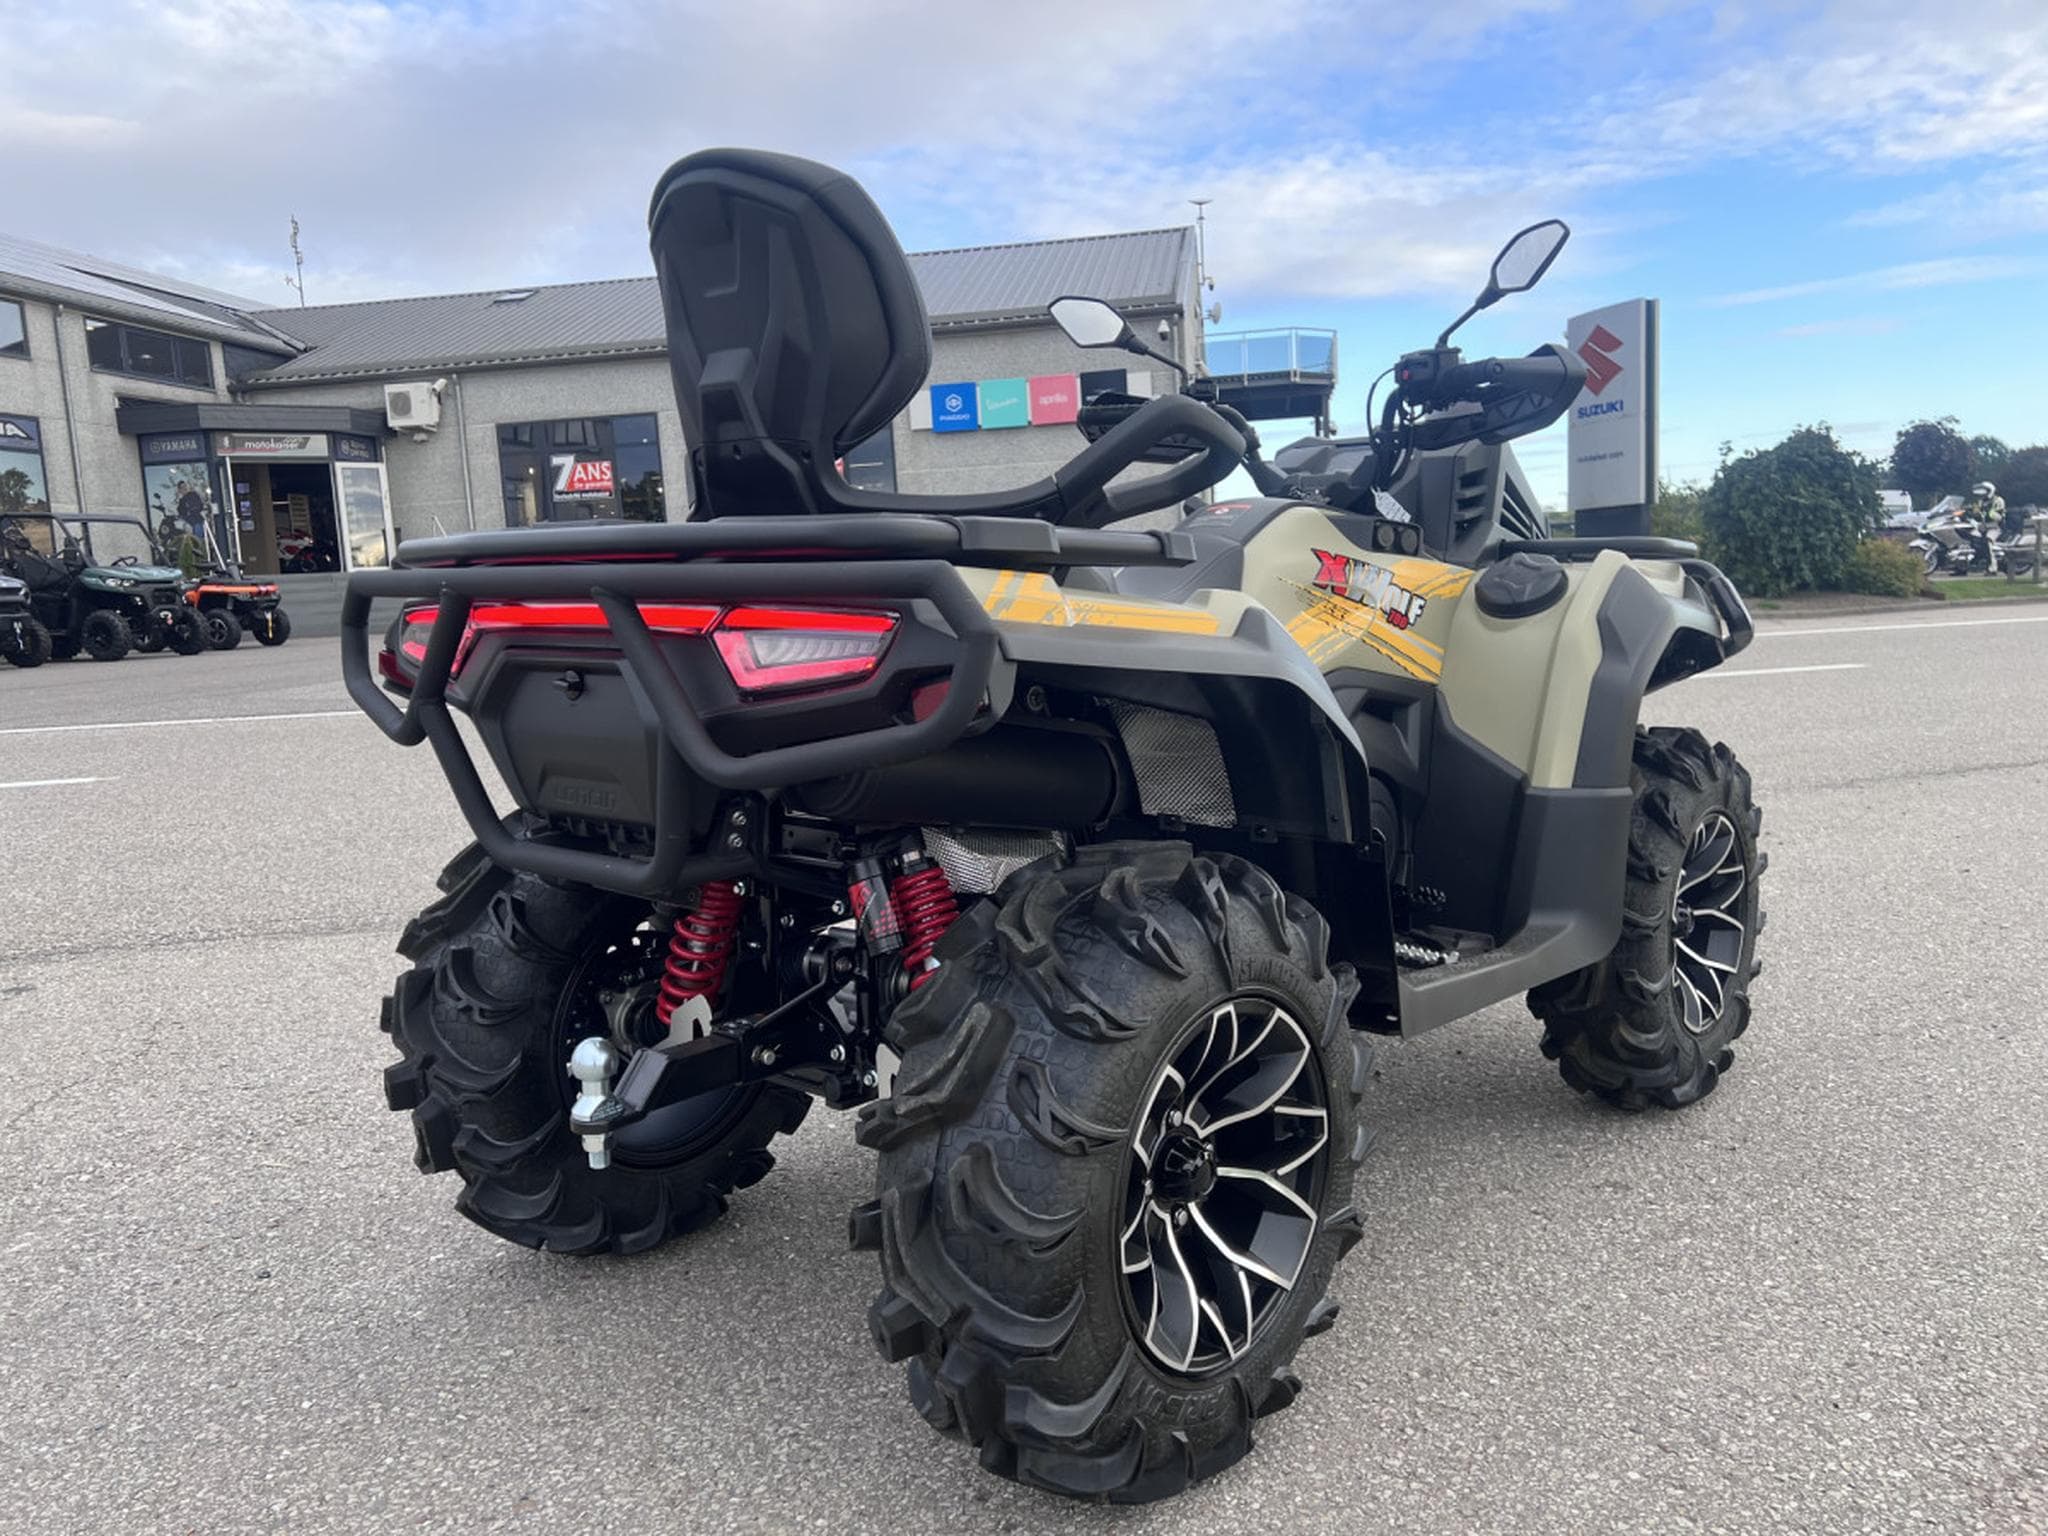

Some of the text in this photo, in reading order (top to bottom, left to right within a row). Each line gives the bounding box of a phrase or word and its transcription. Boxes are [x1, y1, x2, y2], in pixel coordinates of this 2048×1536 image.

[1578, 400, 1624, 419] SUZUKI
[550, 454, 611, 491] 7 ANS
